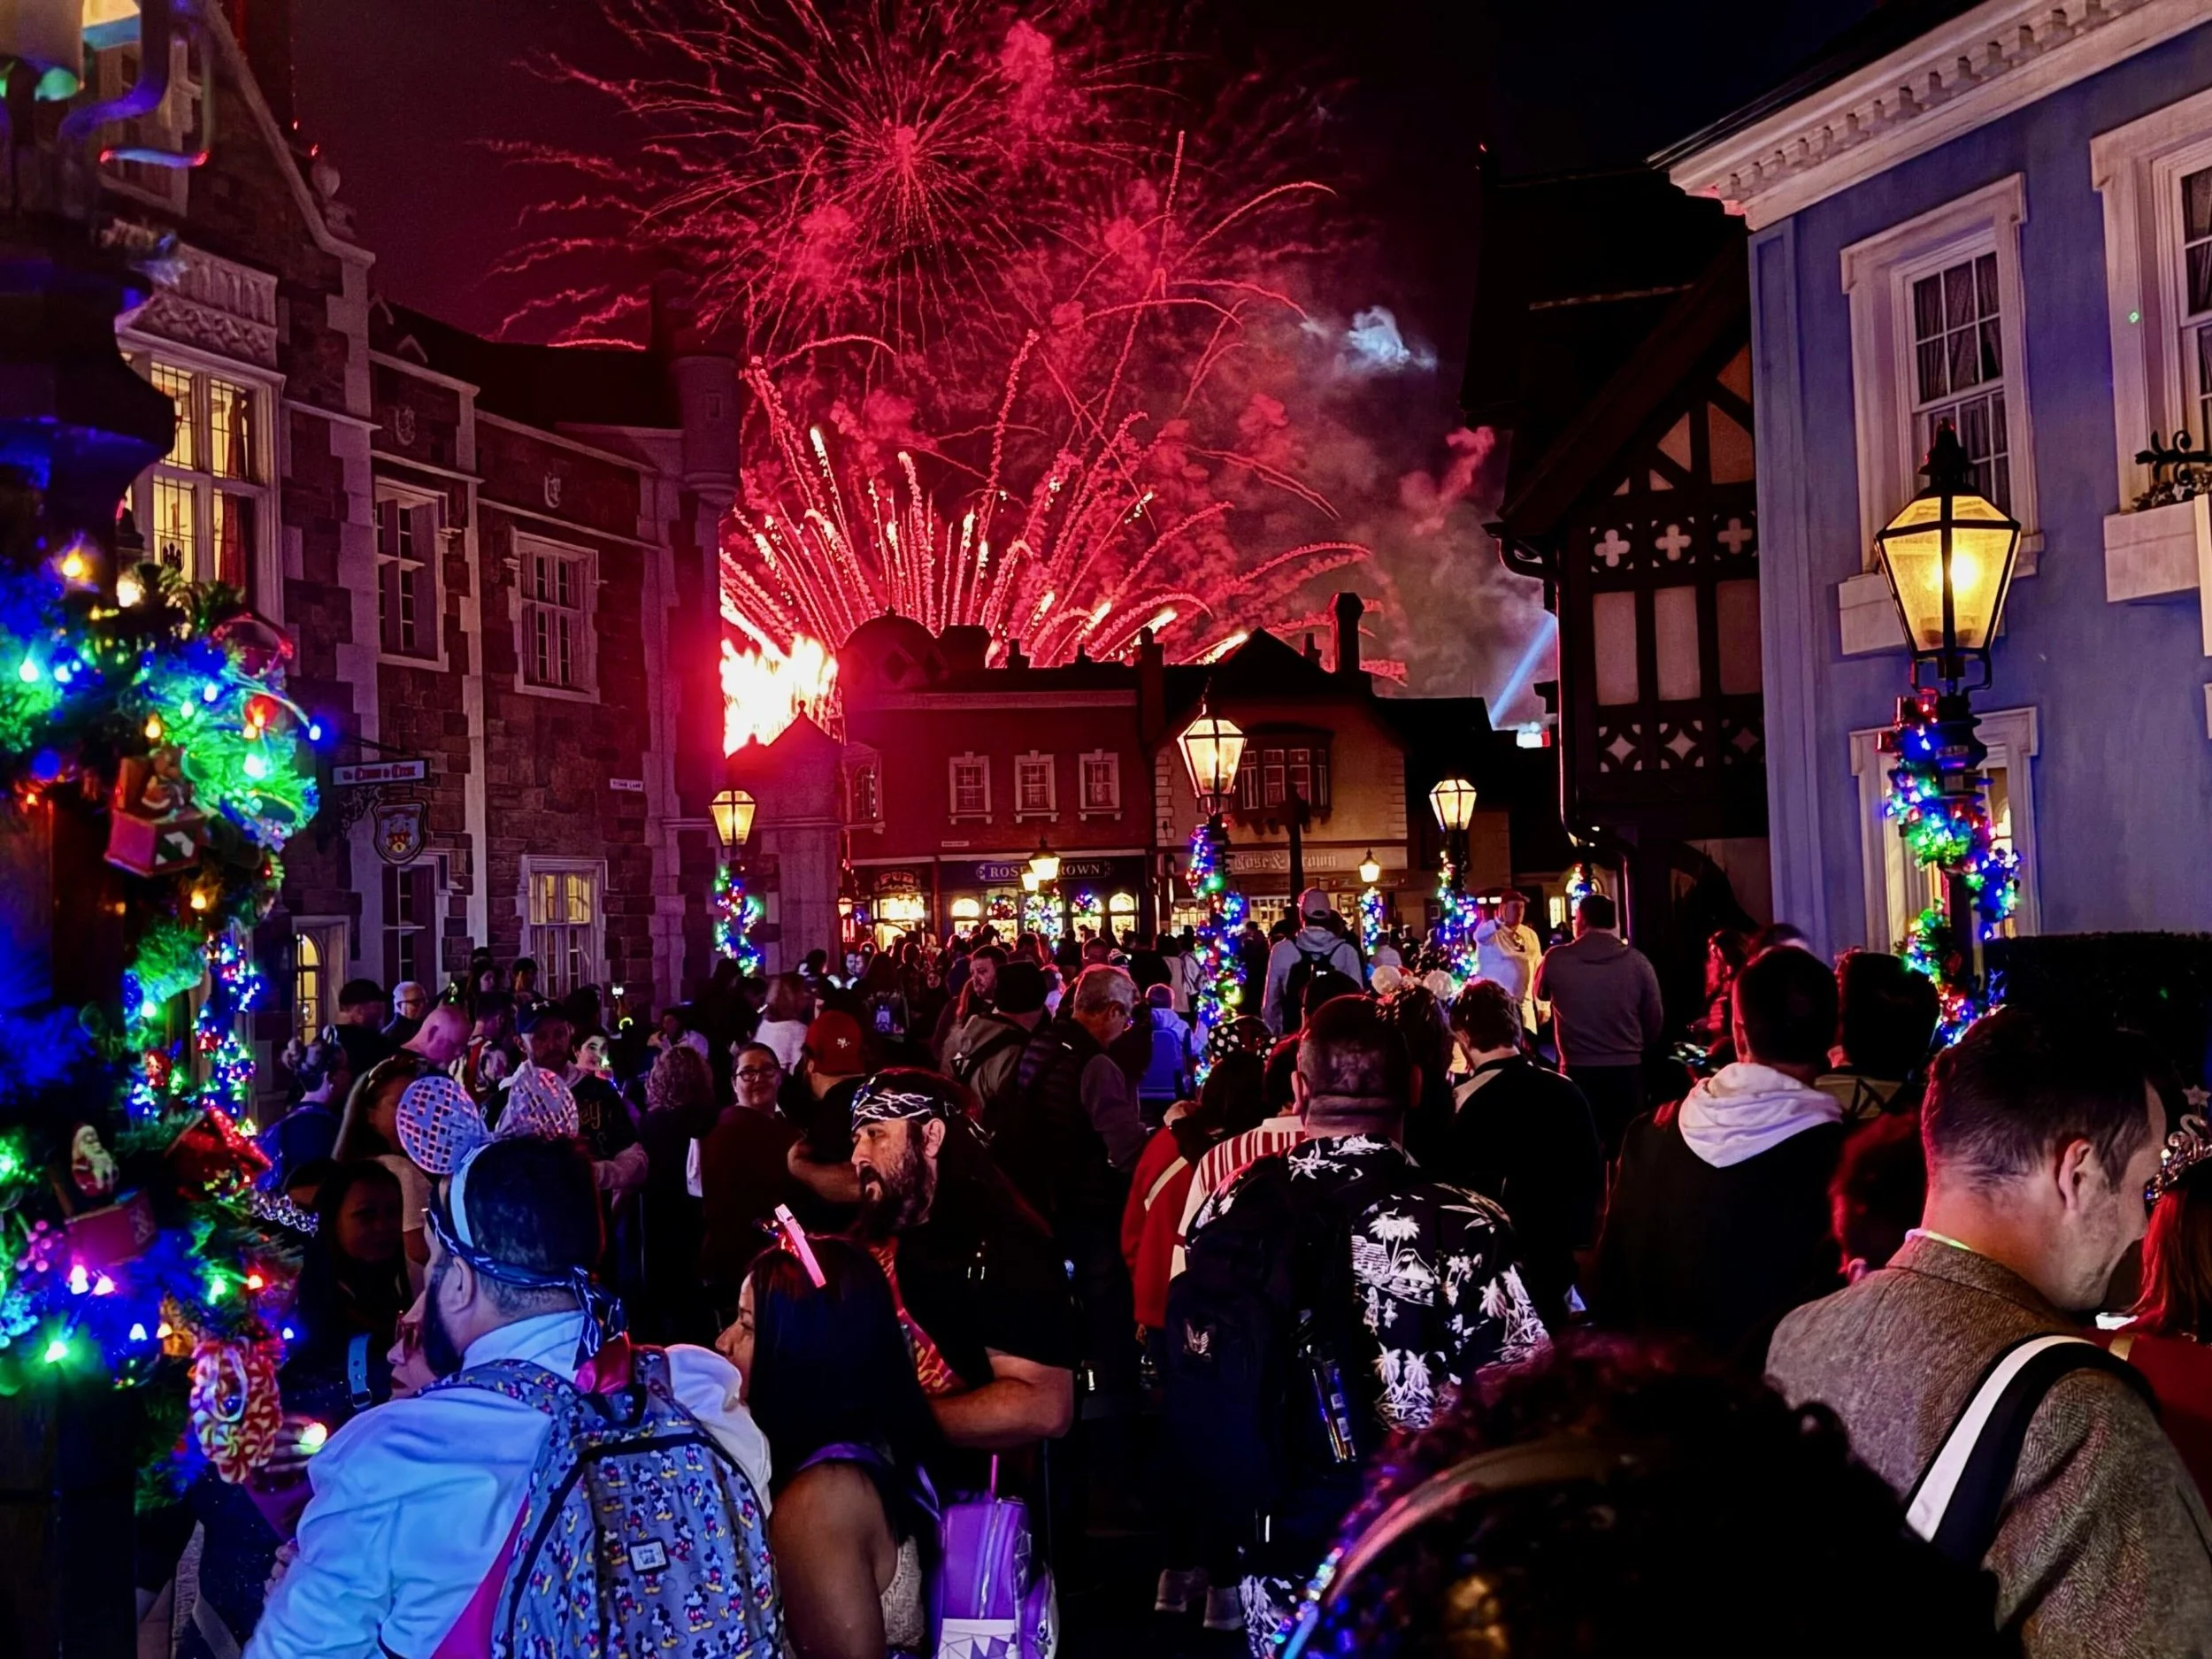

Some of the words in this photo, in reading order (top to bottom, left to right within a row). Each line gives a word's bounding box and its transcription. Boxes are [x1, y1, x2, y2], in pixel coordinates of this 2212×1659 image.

[1302, 855, 1337, 868] rown
[1058, 864, 1100, 876] ROWN
[879, 871, 915, 886] PUB
